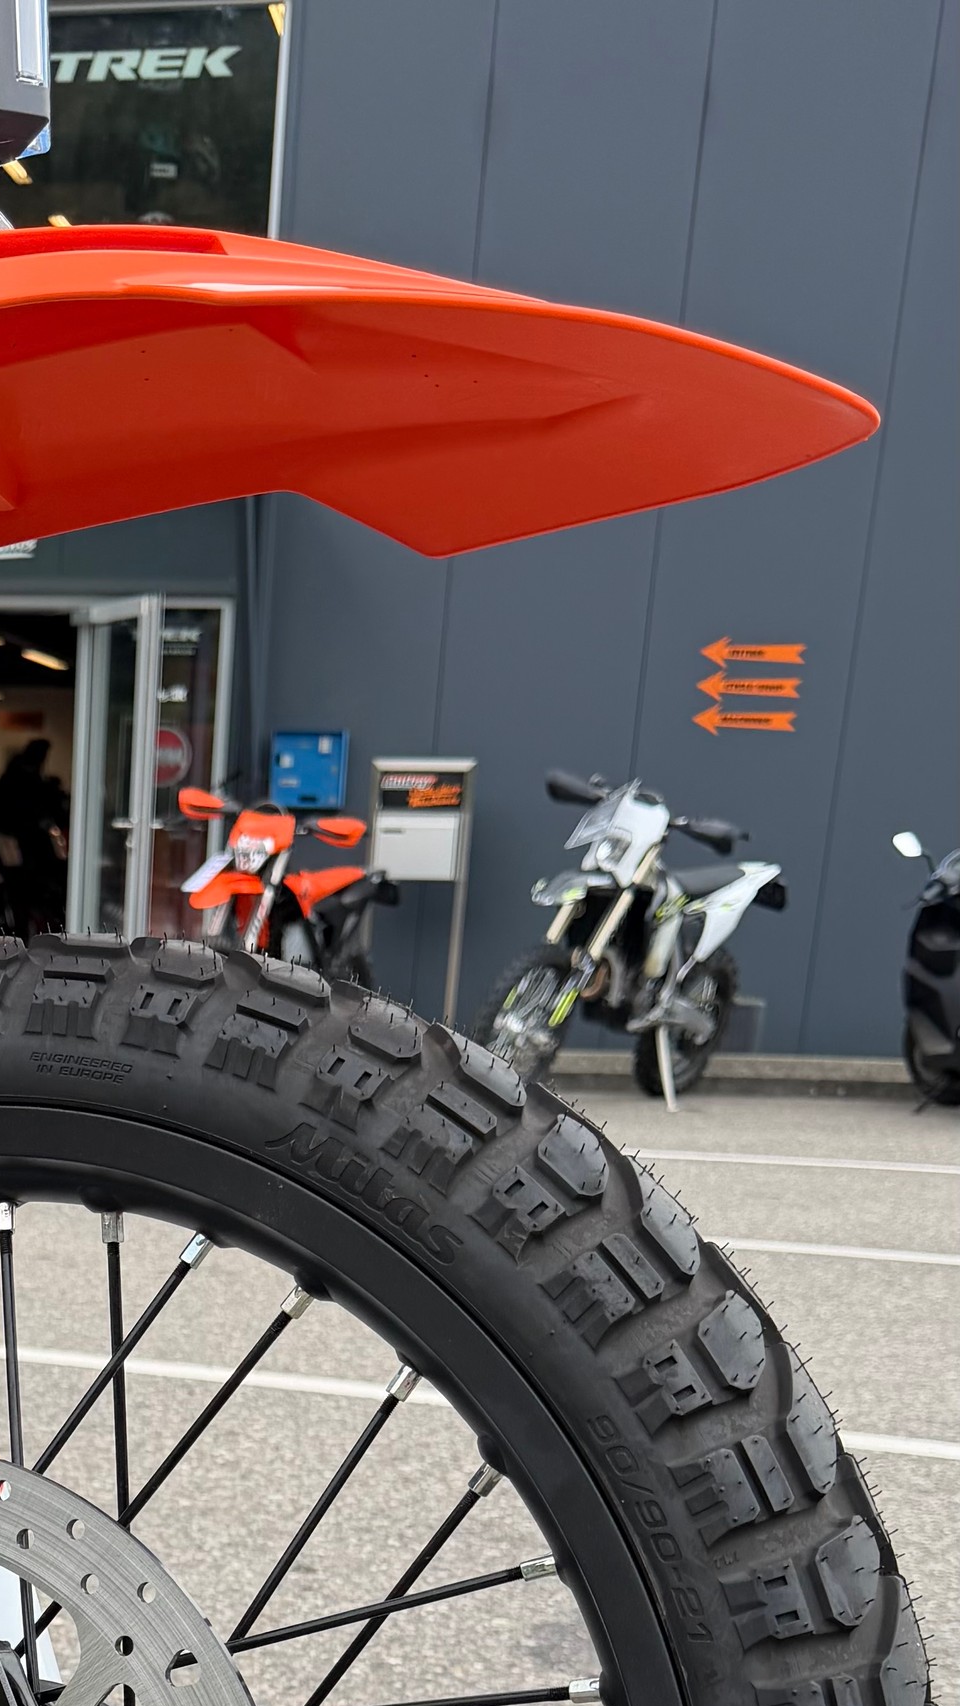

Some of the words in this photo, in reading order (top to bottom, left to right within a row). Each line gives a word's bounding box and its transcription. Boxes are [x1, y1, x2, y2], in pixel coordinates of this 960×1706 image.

[50, 46, 242, 83] TREK
[29, 1051, 133, 1073] ENGINEERED
[36, 1064, 54, 1074] IN
[58, 1065, 125, 1084] EUROPE
[588, 1414, 712, 1642] 90/90-21
